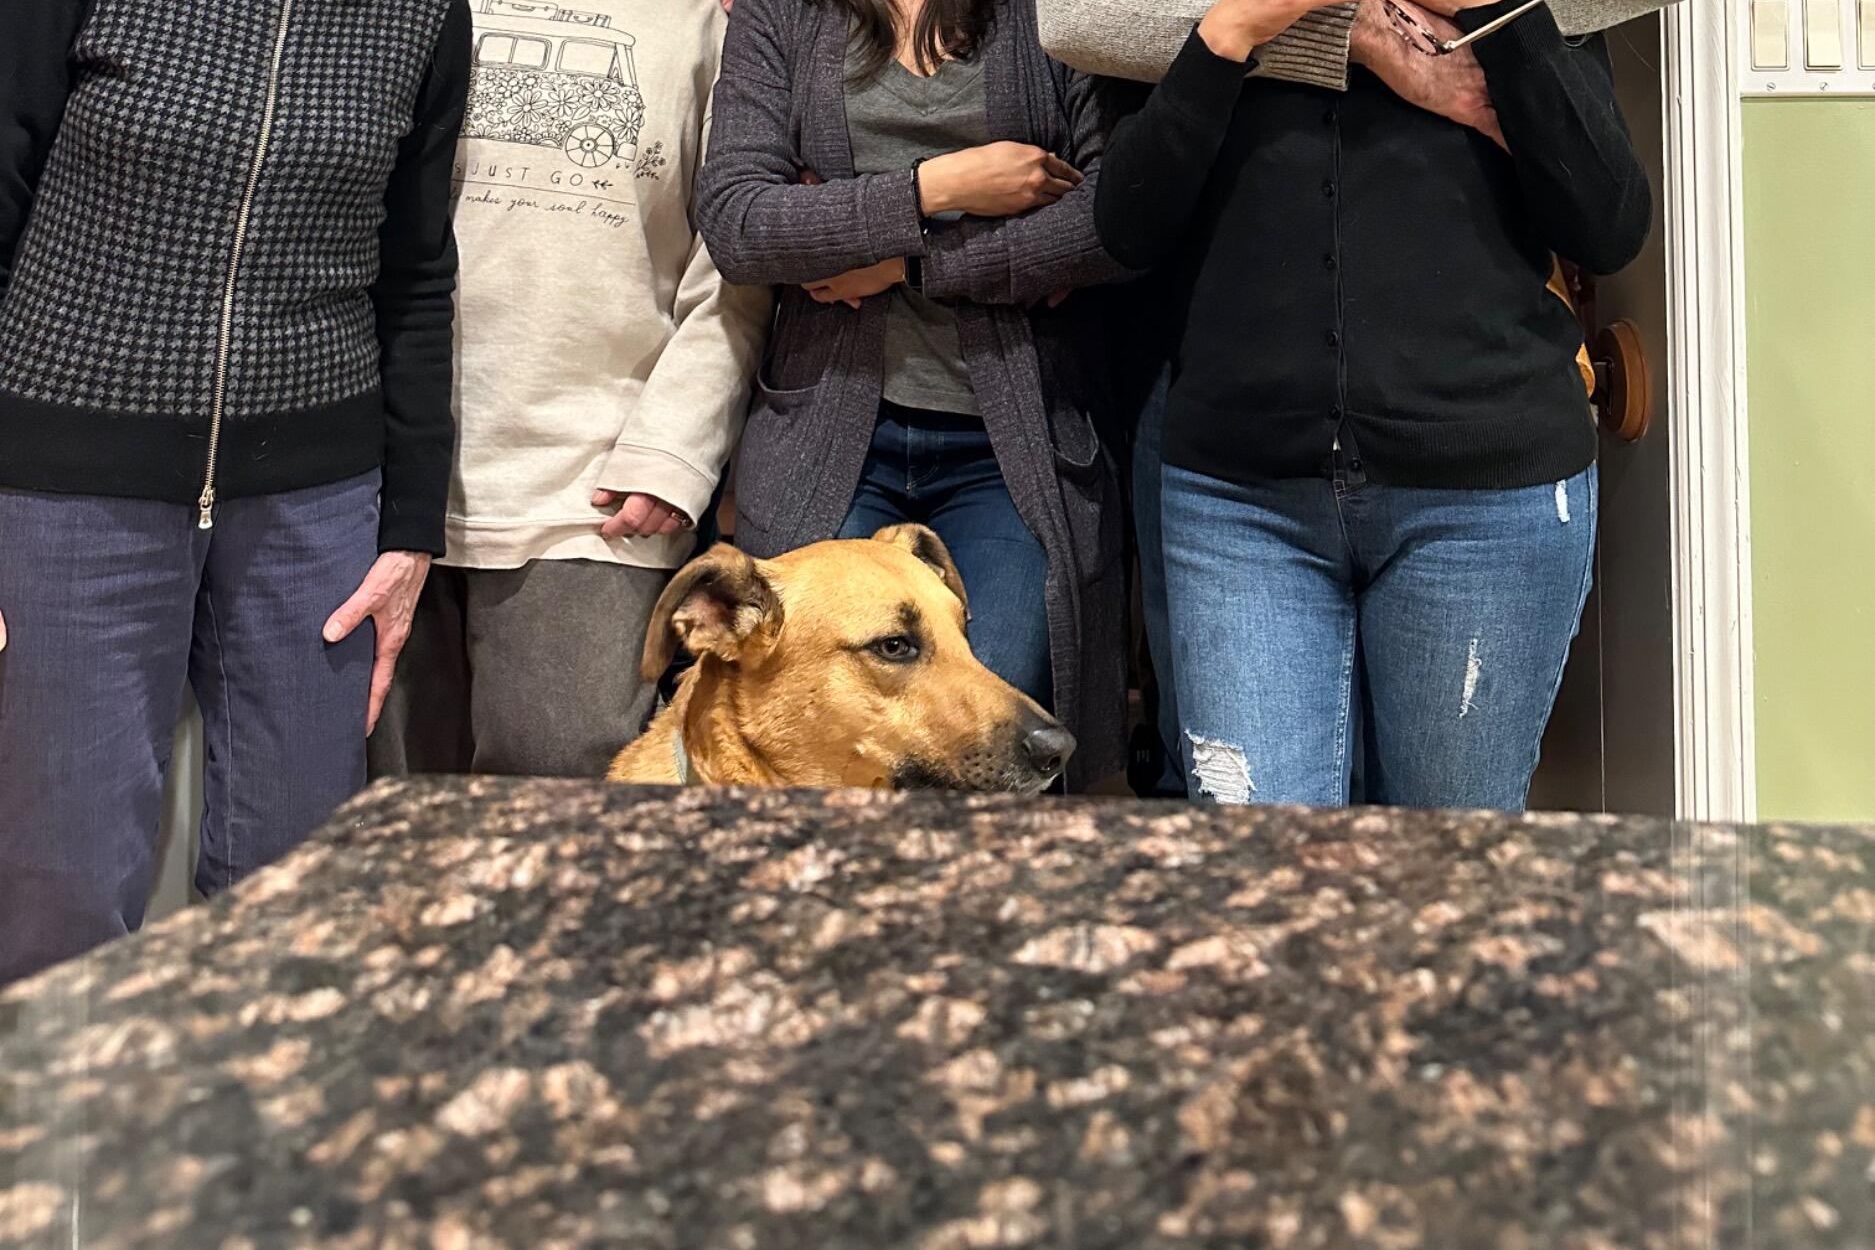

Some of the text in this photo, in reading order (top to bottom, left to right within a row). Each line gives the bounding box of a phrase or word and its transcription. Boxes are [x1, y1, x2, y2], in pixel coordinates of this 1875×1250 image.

[471, 162, 531, 181] JUST
[550, 170, 584, 187] GO
[465, 189, 503, 205] makes
[507, 197, 540, 212] your
[544, 200, 588, 214] soul
[591, 202, 630, 228] happy
